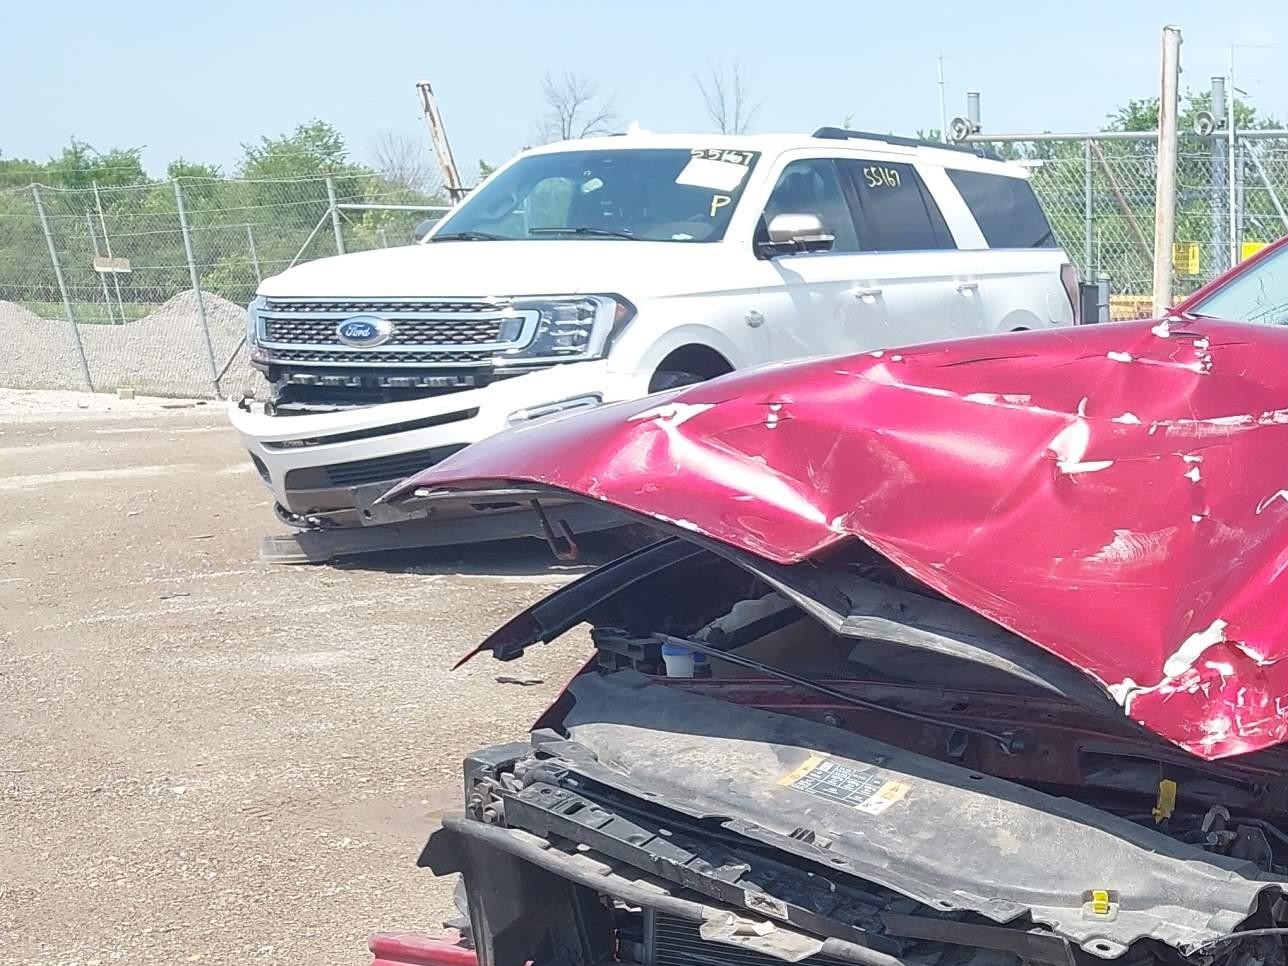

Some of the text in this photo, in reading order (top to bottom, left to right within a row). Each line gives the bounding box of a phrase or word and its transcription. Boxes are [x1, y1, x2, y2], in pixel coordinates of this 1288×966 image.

[863, 166, 902, 188] 55167
[710, 195, 732, 217] P
[345, 323, 371, 337] Ford
